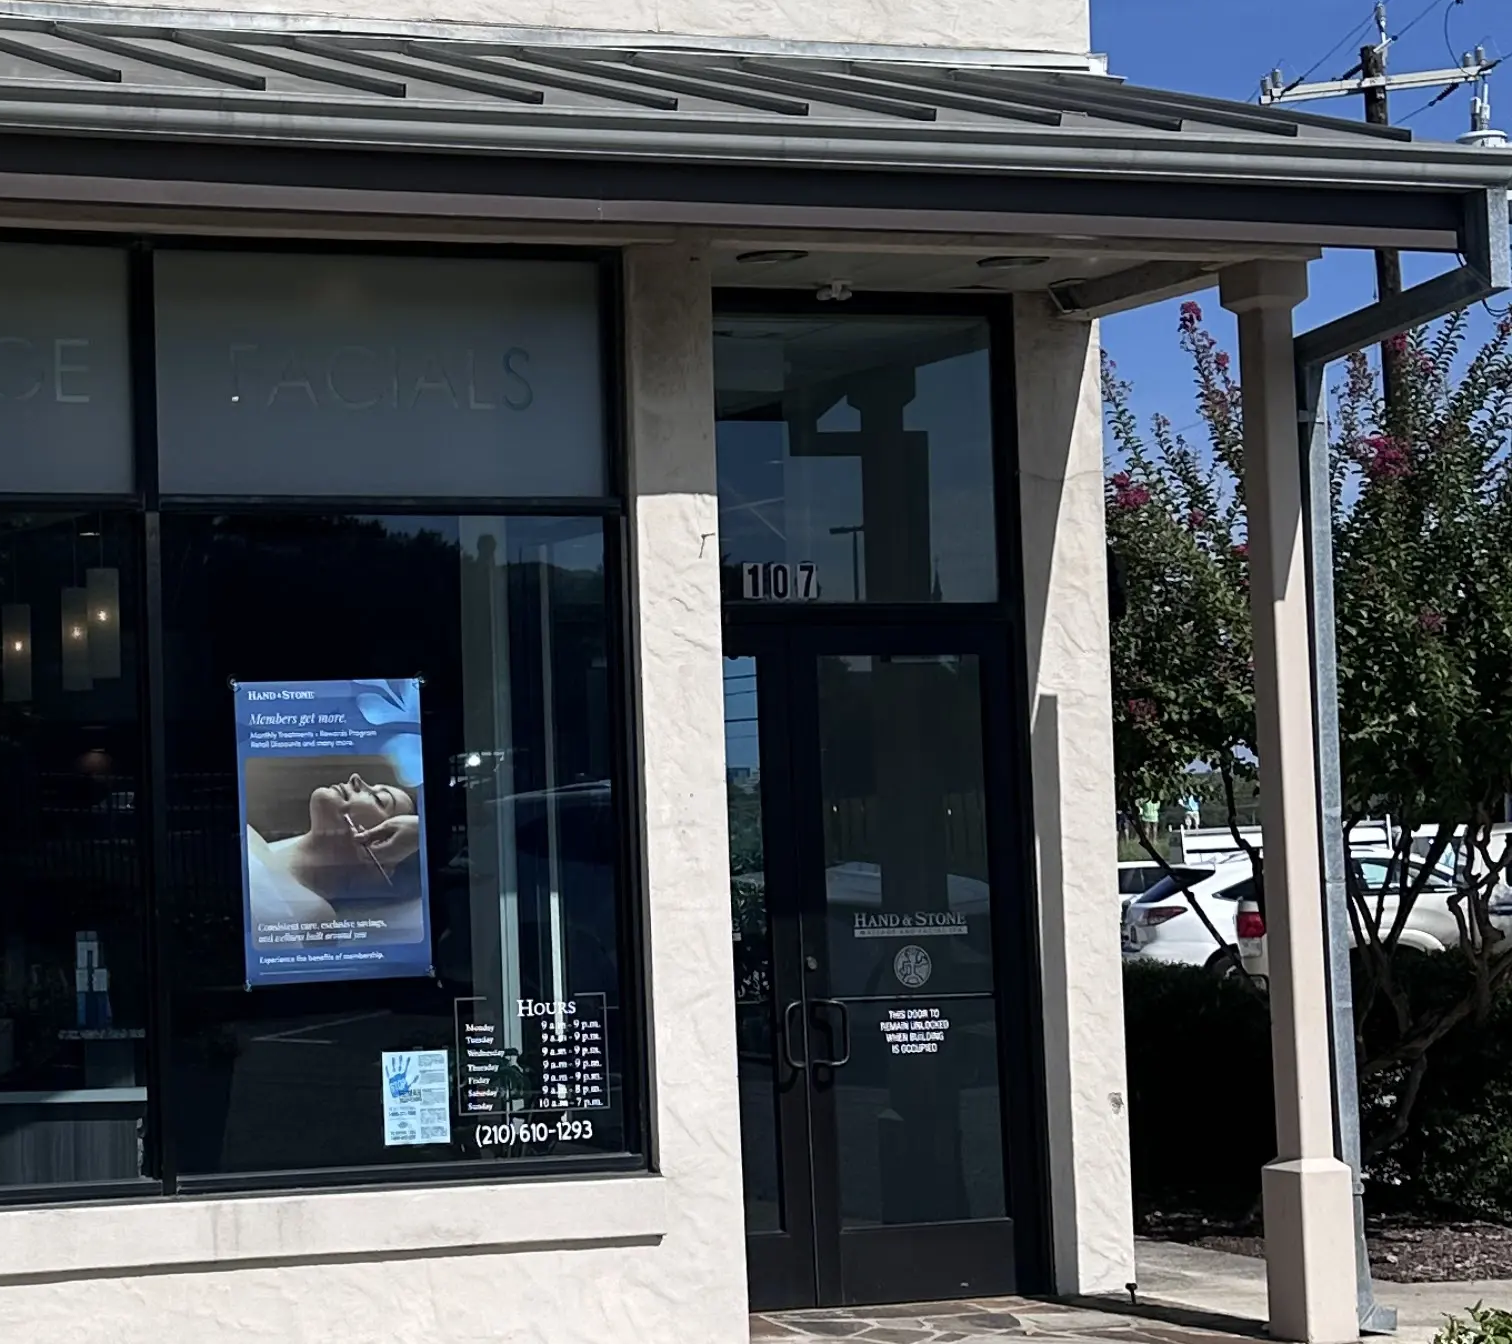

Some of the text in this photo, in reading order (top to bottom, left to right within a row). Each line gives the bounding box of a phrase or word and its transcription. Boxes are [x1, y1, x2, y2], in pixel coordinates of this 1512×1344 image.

[747, 564, 814, 598] 107
[249, 713, 347, 727] Members get more.
[854, 912, 966, 928] HAND & STONE
[517, 999, 577, 1017] HOURS
[929, 1008, 940, 1018] TO
[465, 1023, 495, 1033] Monday
[541, 1020, 547, 1030] 9
[573, 1019, 580, 1028] 9
[541, 1033, 548, 1043] 9
[574, 1031, 580, 1041] 9
[541, 1047, 548, 1056] 9
[574, 1045, 580, 1054] 9
[892, 1043, 900, 1054] IS
[543, 1060, 549, 1069] 9
[575, 1058, 581, 1067] 9
[543, 1073, 549, 1082] 9
[575, 1072, 581, 1081] 9
[542, 1085, 549, 1094] 9
[468, 1102, 493, 1111] Sunday
[539, 1098, 550, 1108] 10
[576, 1097, 582, 1106] 7
[475, 1120, 593, 1148] (210) 610-1293
